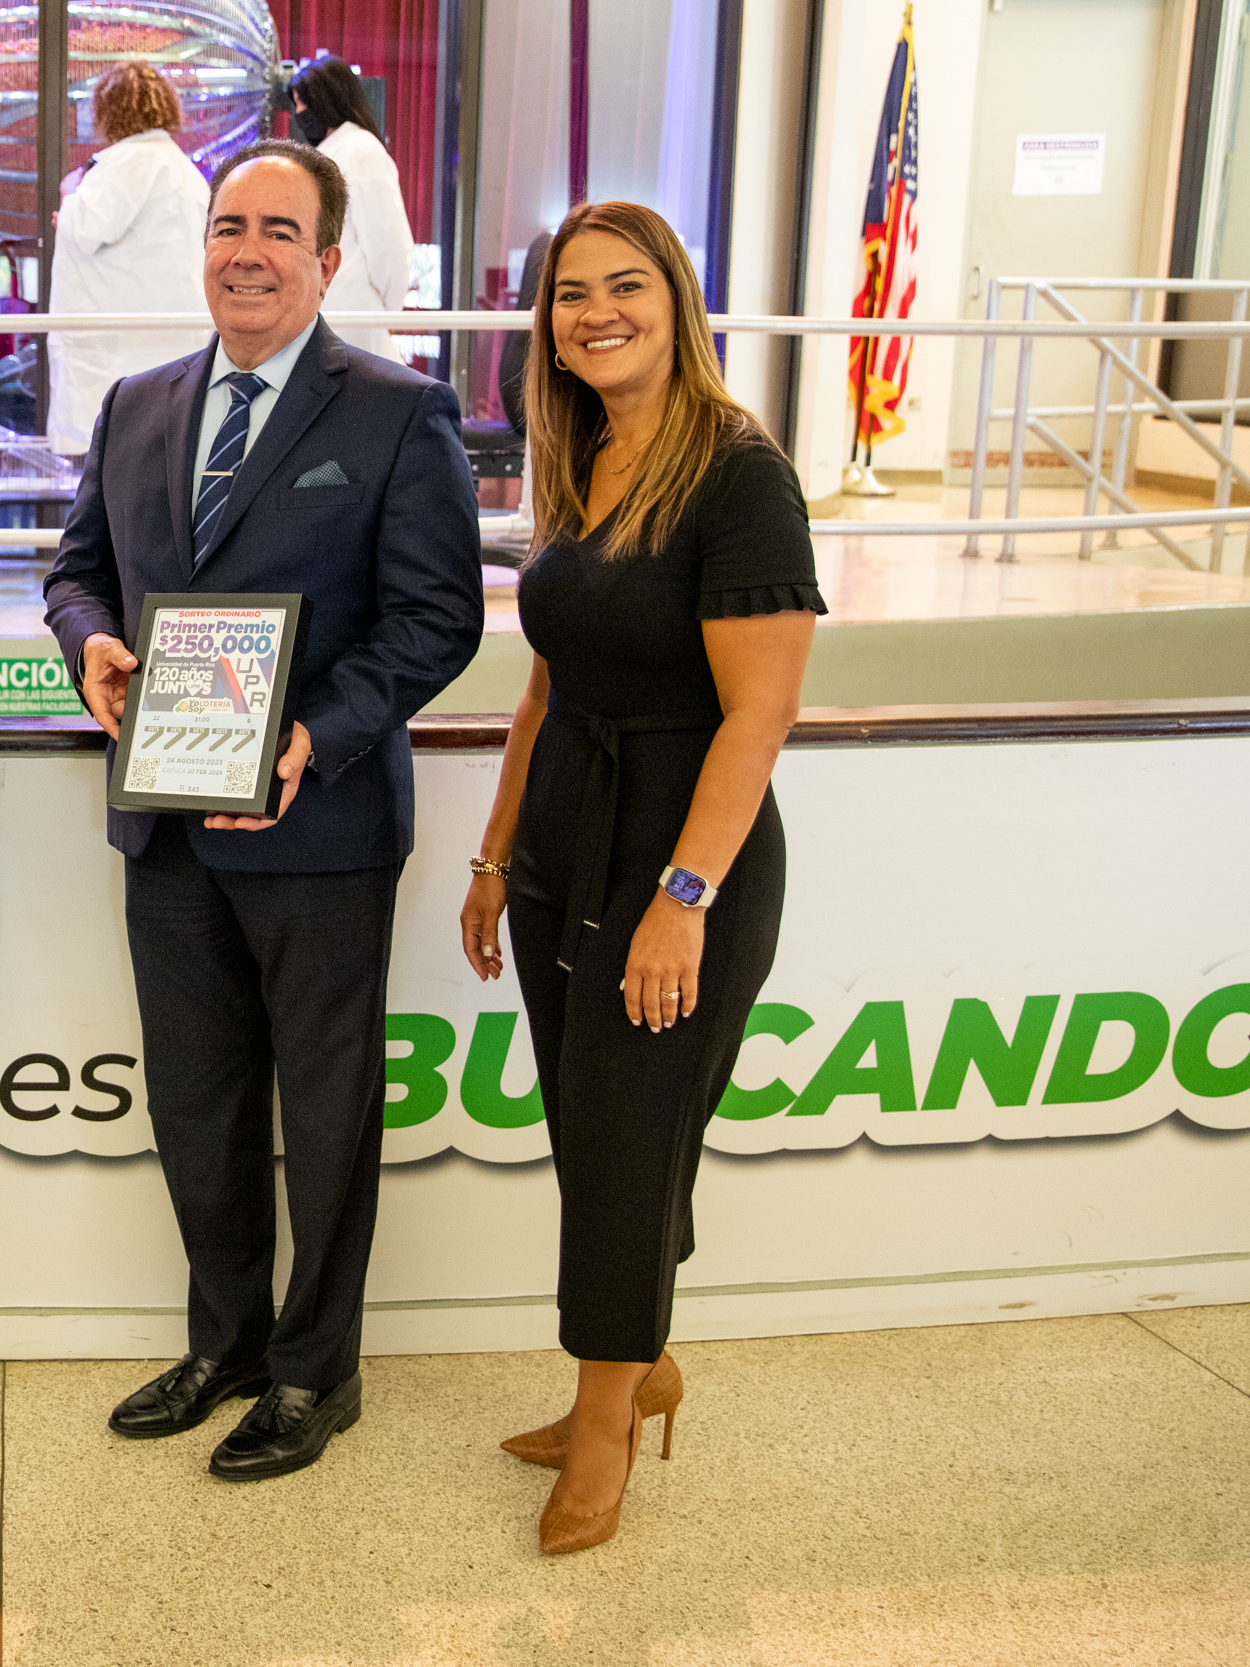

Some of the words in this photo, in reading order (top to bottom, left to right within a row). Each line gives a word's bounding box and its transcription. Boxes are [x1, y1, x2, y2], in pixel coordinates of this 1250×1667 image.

[179, 610, 212, 618] SORTEO
[214, 610, 261, 618] ORDINARIO
[158, 634, 272, 657] $250,000
[153, 667, 179, 681] 120
[181, 666, 213, 681] años
[188, 706, 205, 714] Soy
[383, 982, 1250, 1129] BUCANDO
